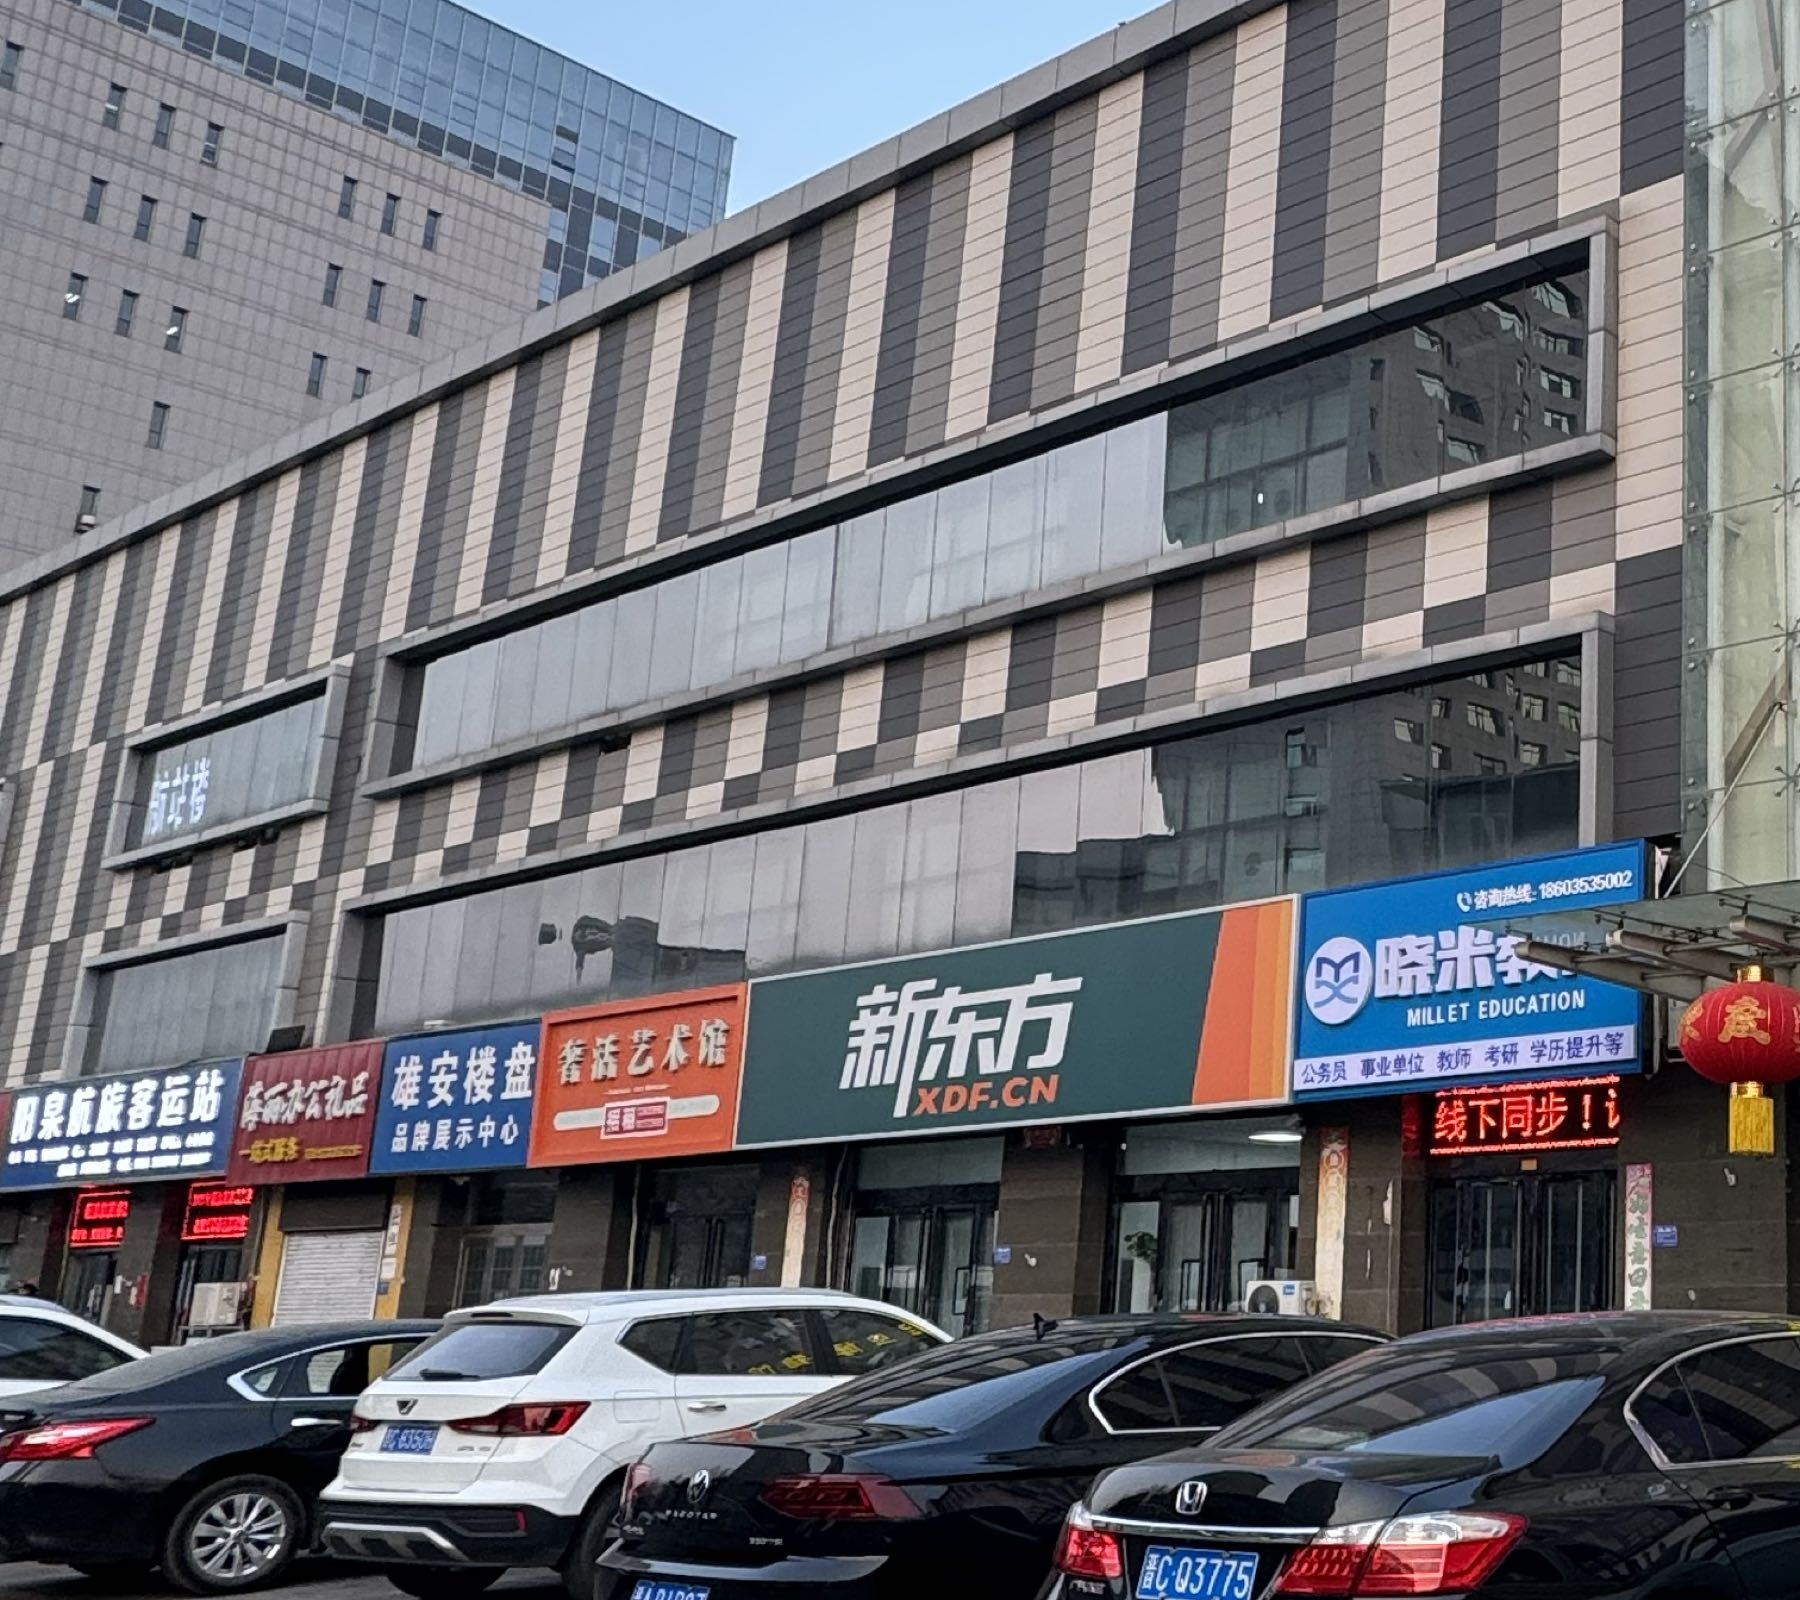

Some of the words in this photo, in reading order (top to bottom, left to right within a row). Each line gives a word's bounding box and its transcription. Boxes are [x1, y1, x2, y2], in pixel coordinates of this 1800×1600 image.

[1374, 925, 1577, 999] 晓米教
[1406, 1002, 1470, 1028] MILLET
[1478, 989, 1586, 1020] EDUCATION
[839, 973, 1084, 1118] 新东方
[1301, 1061, 1347, 1084] 公务员
[1361, 1052, 1424, 1080] 事业单位
[1437, 1048, 1471, 1072] 教师
[1484, 1042, 1519, 1067] 考研
[1530, 1032, 1624, 1064] 学历提升等
[391, 1041, 536, 1111] 雄安楼盘
[913, 1074, 1060, 1117] XDF.CN
[391, 1114, 519, 1153] 品牌展示中心
